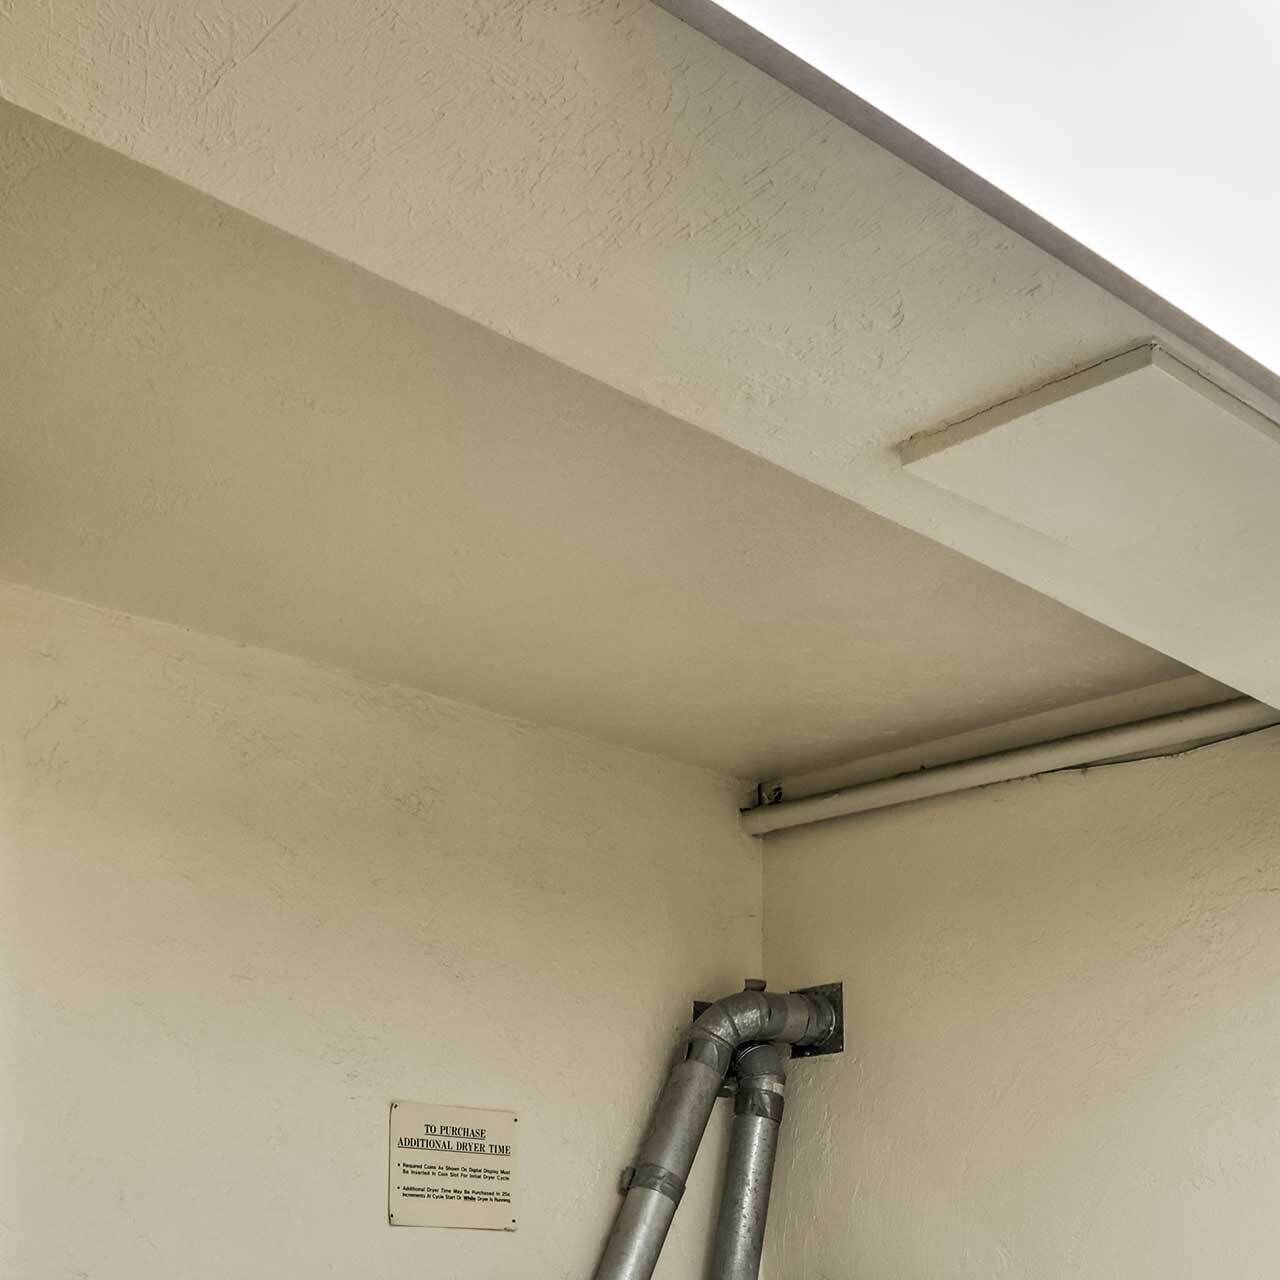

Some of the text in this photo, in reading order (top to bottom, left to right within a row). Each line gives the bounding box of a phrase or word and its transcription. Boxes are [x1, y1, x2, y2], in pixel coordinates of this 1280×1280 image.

[424, 1124, 486, 1138] TO PURCHASE
[398, 1137, 510, 1154] ADDITIONAL DRYER TIME
